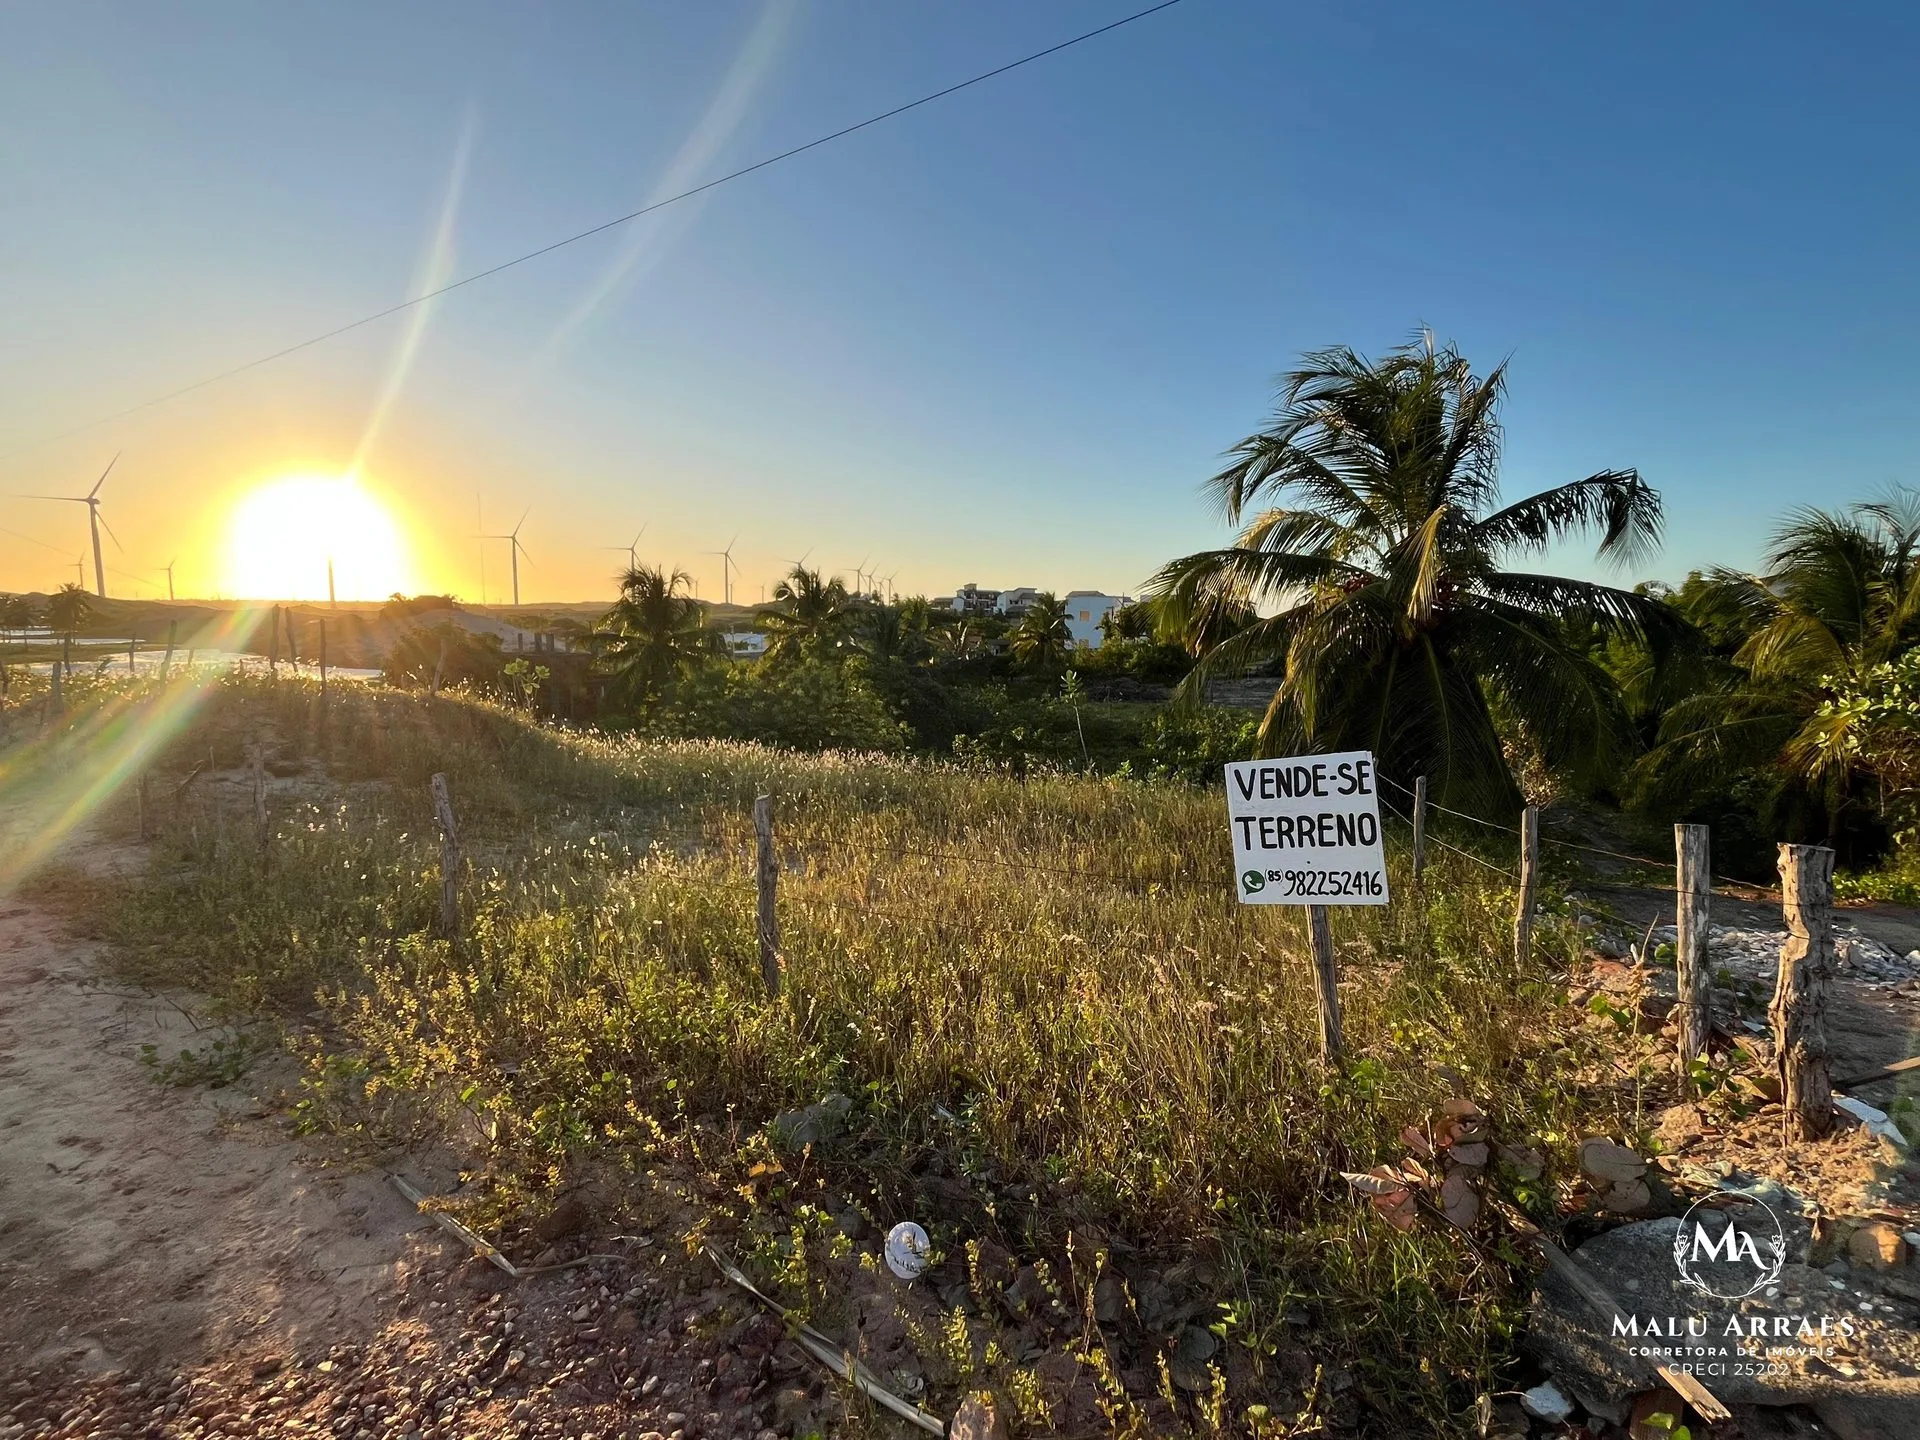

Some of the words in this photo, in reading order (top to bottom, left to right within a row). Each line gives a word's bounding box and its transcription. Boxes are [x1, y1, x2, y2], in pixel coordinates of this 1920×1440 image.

[1234, 760, 1372, 801] VENDE-SE
[1235, 812, 1377, 851] TERRENO
[1264, 868, 1284, 883] (85)
[1284, 870, 1383, 897] 982252416
